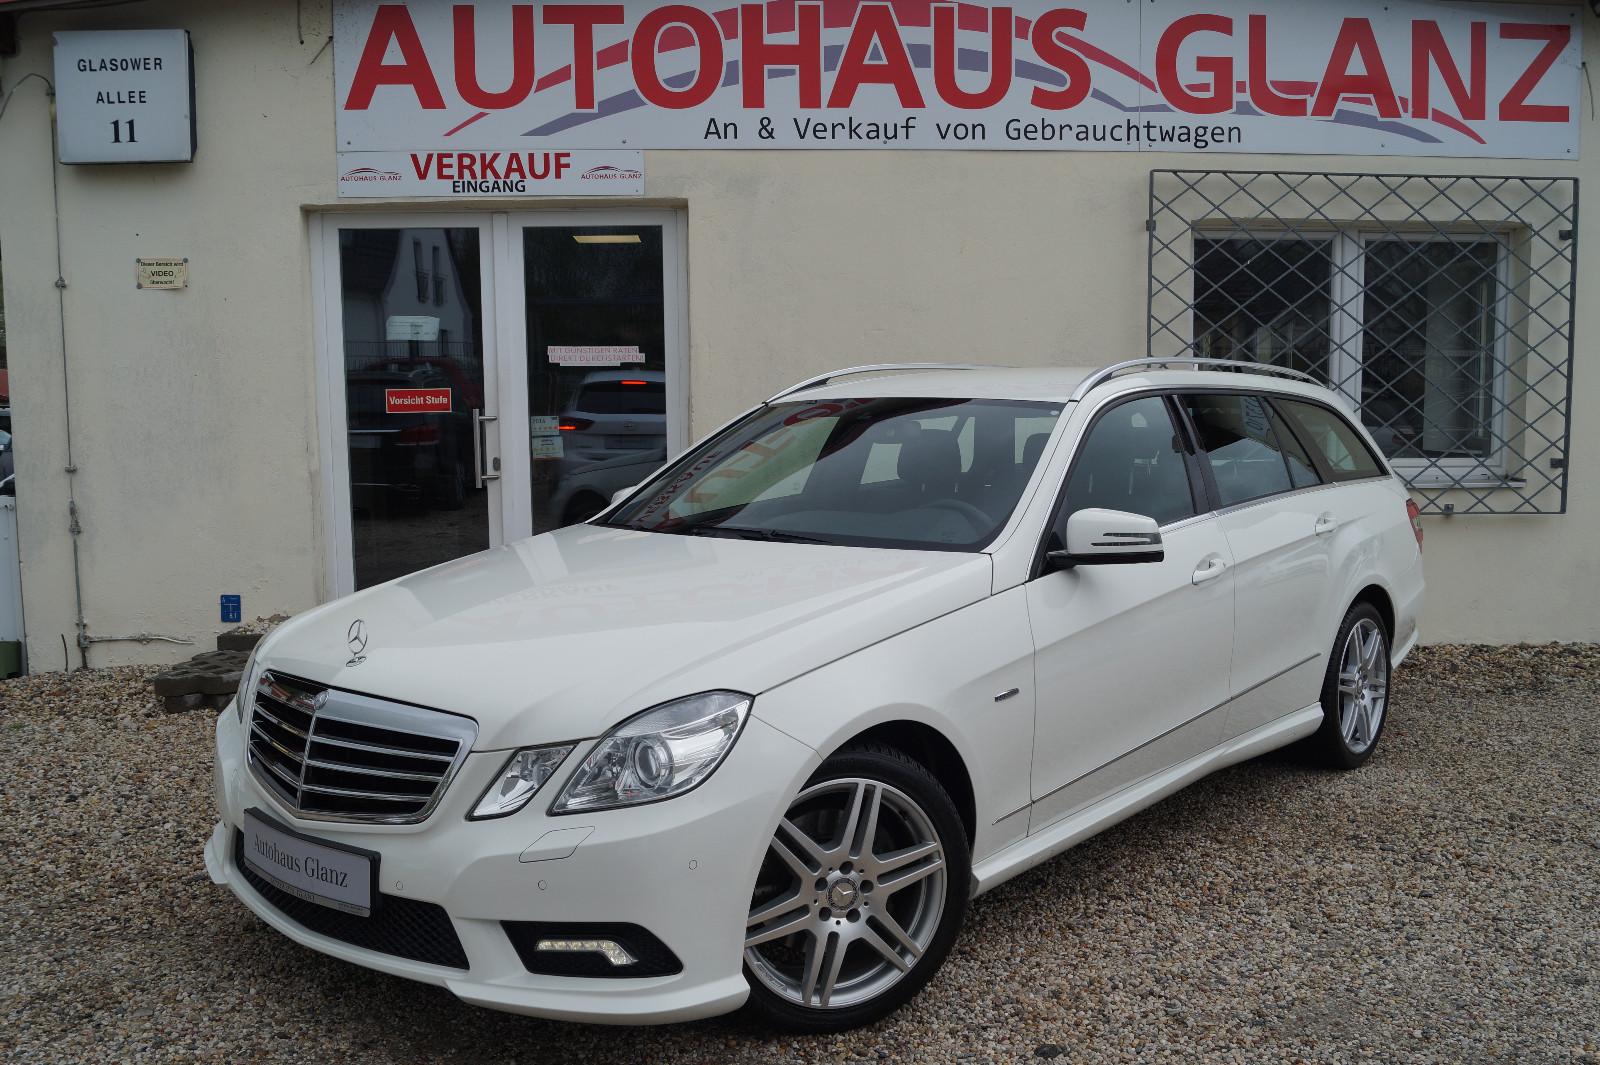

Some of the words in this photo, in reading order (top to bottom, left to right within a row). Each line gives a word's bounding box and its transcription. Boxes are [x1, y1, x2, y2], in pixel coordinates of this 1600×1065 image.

[77, 57, 164, 73] GLASOWER
[345, 4, 1093, 110] AUTOHAUS
[1155, 12, 1571, 124] GLANZ
[96, 90, 148, 105] ALLEE
[110, 118, 138, 144] 11
[703, 117, 738, 140] An
[757, 116, 776, 140] &
[793, 116, 917, 140] Verkauf
[935, 122, 986, 141] von
[1005, 117, 1242, 149] Gebrauchtwagen
[410, 152, 571, 181] VERKAUF
[452, 180, 527, 194] EINGANG
[389, 395, 424, 405] Vorsicht
[425, 395, 448, 405] Stufe
[254, 831, 301, 873] Autohaus
[304, 855, 349, 889] Glanz
